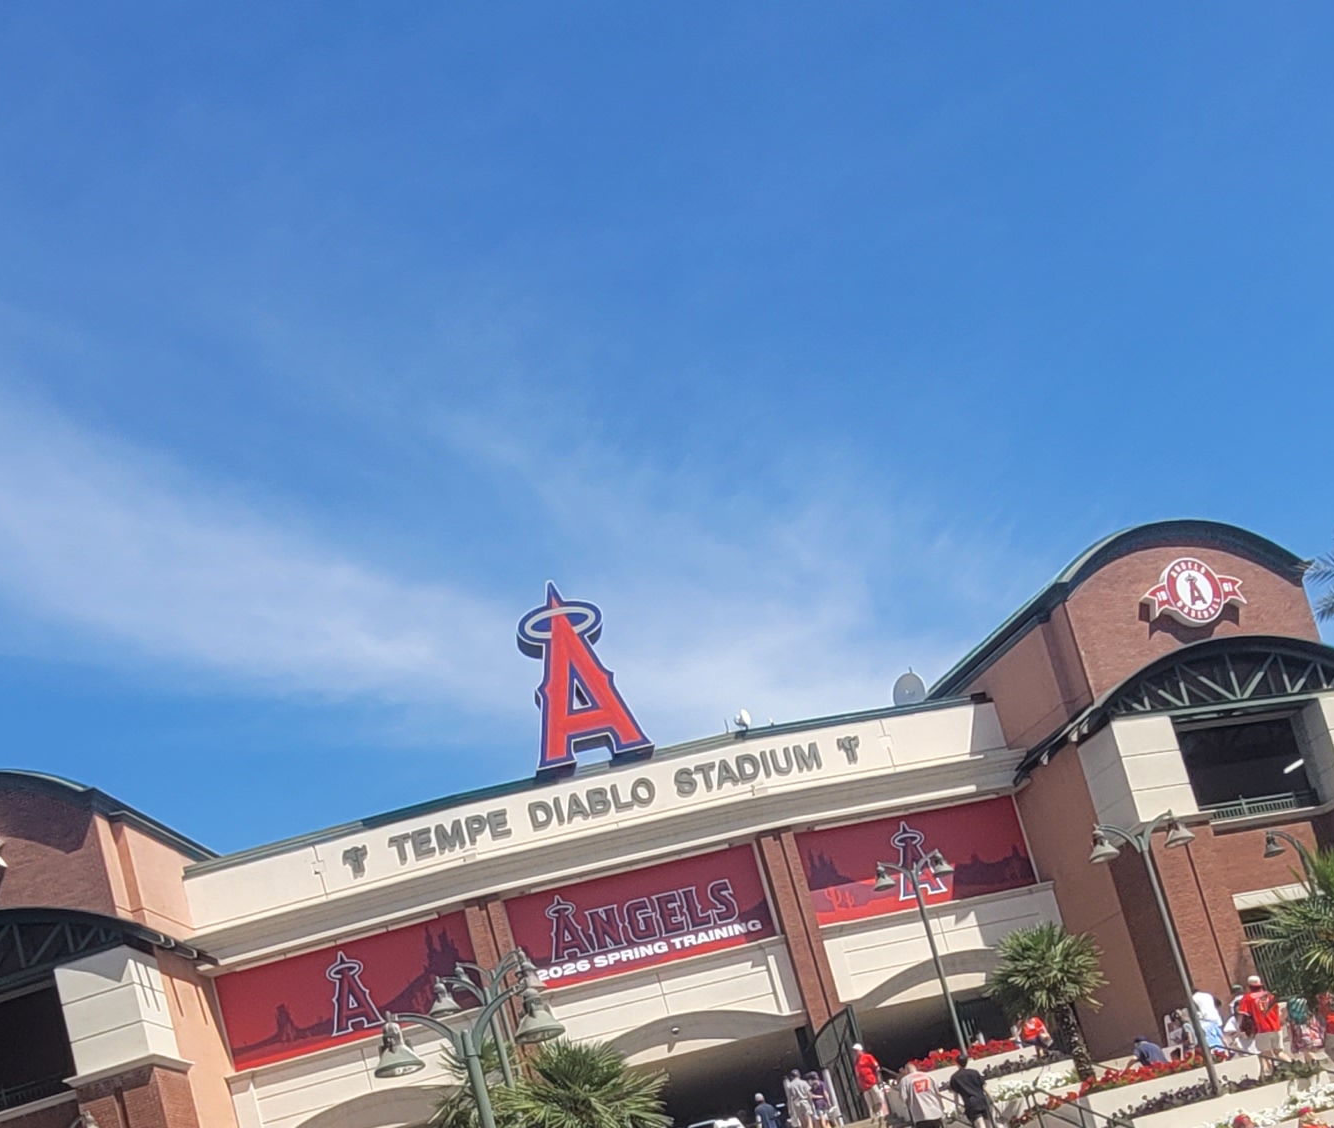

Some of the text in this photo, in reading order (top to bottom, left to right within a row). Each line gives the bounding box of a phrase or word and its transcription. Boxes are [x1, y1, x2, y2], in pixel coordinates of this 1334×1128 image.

[1170, 561, 1205, 578] ANGELS
[516, 580, 655, 773] A
[387, 807, 513, 866] TEMPE
[526, 776, 657, 833] DIABLO
[673, 741, 824, 798] STADIUM
[535, 918, 763, 982] 2026 SPRING TRAINING
[544, 878, 740, 964] ANGELS
[325, 950, 387, 1037] A
